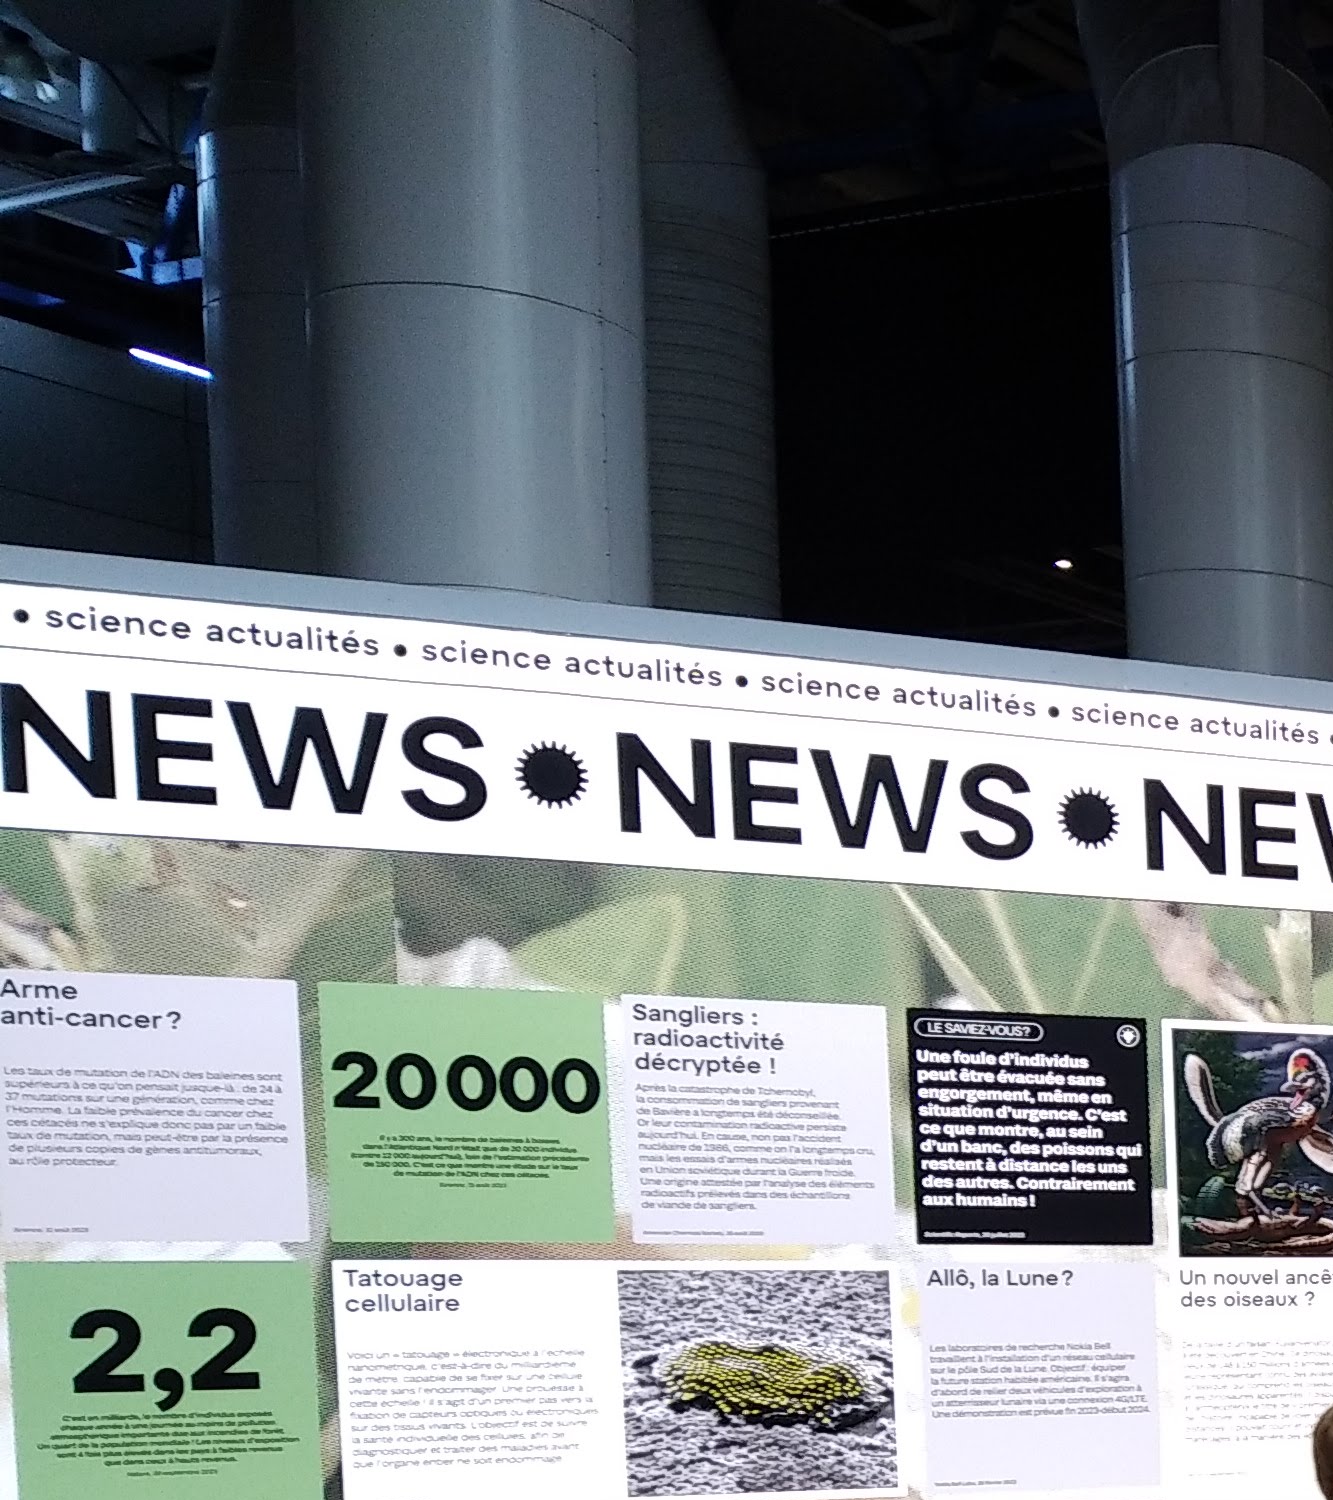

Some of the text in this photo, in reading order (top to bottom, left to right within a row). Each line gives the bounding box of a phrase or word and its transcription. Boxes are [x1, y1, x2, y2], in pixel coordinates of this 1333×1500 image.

[46, 606, 191, 640] science
[206, 623, 379, 656] actualités
[422, 640, 551, 670] science
[565, 656, 722, 687] actualités
[762, 672, 880, 701] science
[893, 686, 1036, 716] actualités
[1072, 703, 1179, 731] science
[1190, 716, 1319, 744] actualités
[0, 682, 487, 822] NEWS
[616, 732, 1034, 860] NEWS
[0, 979, 78, 1000] Arme
[632, 1003, 744, 1028] Sangliers
[927, 1022, 943, 1033] LE
[634, 1028, 784, 1051] radioactivité
[635, 1052, 761, 1077] décryptée
[916, 1049, 1089, 1068] Une foule d'individus
[916, 1068, 1106, 1086] peut être évacuée sans
[917, 1086, 1112, 1104] engorgement, même en
[917, 1102, 1127, 1123] situation d'urgence. C'est
[919, 1138, 1142, 1159] d'un banc, des poissons qui
[920, 1157, 1128, 1173] restent à distance les uns
[921, 1174, 1135, 1190] des autres. Contrairement
[342, 1269, 463, 1292] Tatouage
[927, 1269, 975, 1289] Allô,
[982, 1269, 999, 1286] la
[1180, 1270, 1206, 1286] Un
[1214, 1269, 1278, 1285] nouvel
[345, 1293, 460, 1312] cellulaire
[1180, 1291, 1216, 1307] des
[1224, 1291, 1298, 1307] oiseaux
[70, 1308, 261, 1412] 2,2
